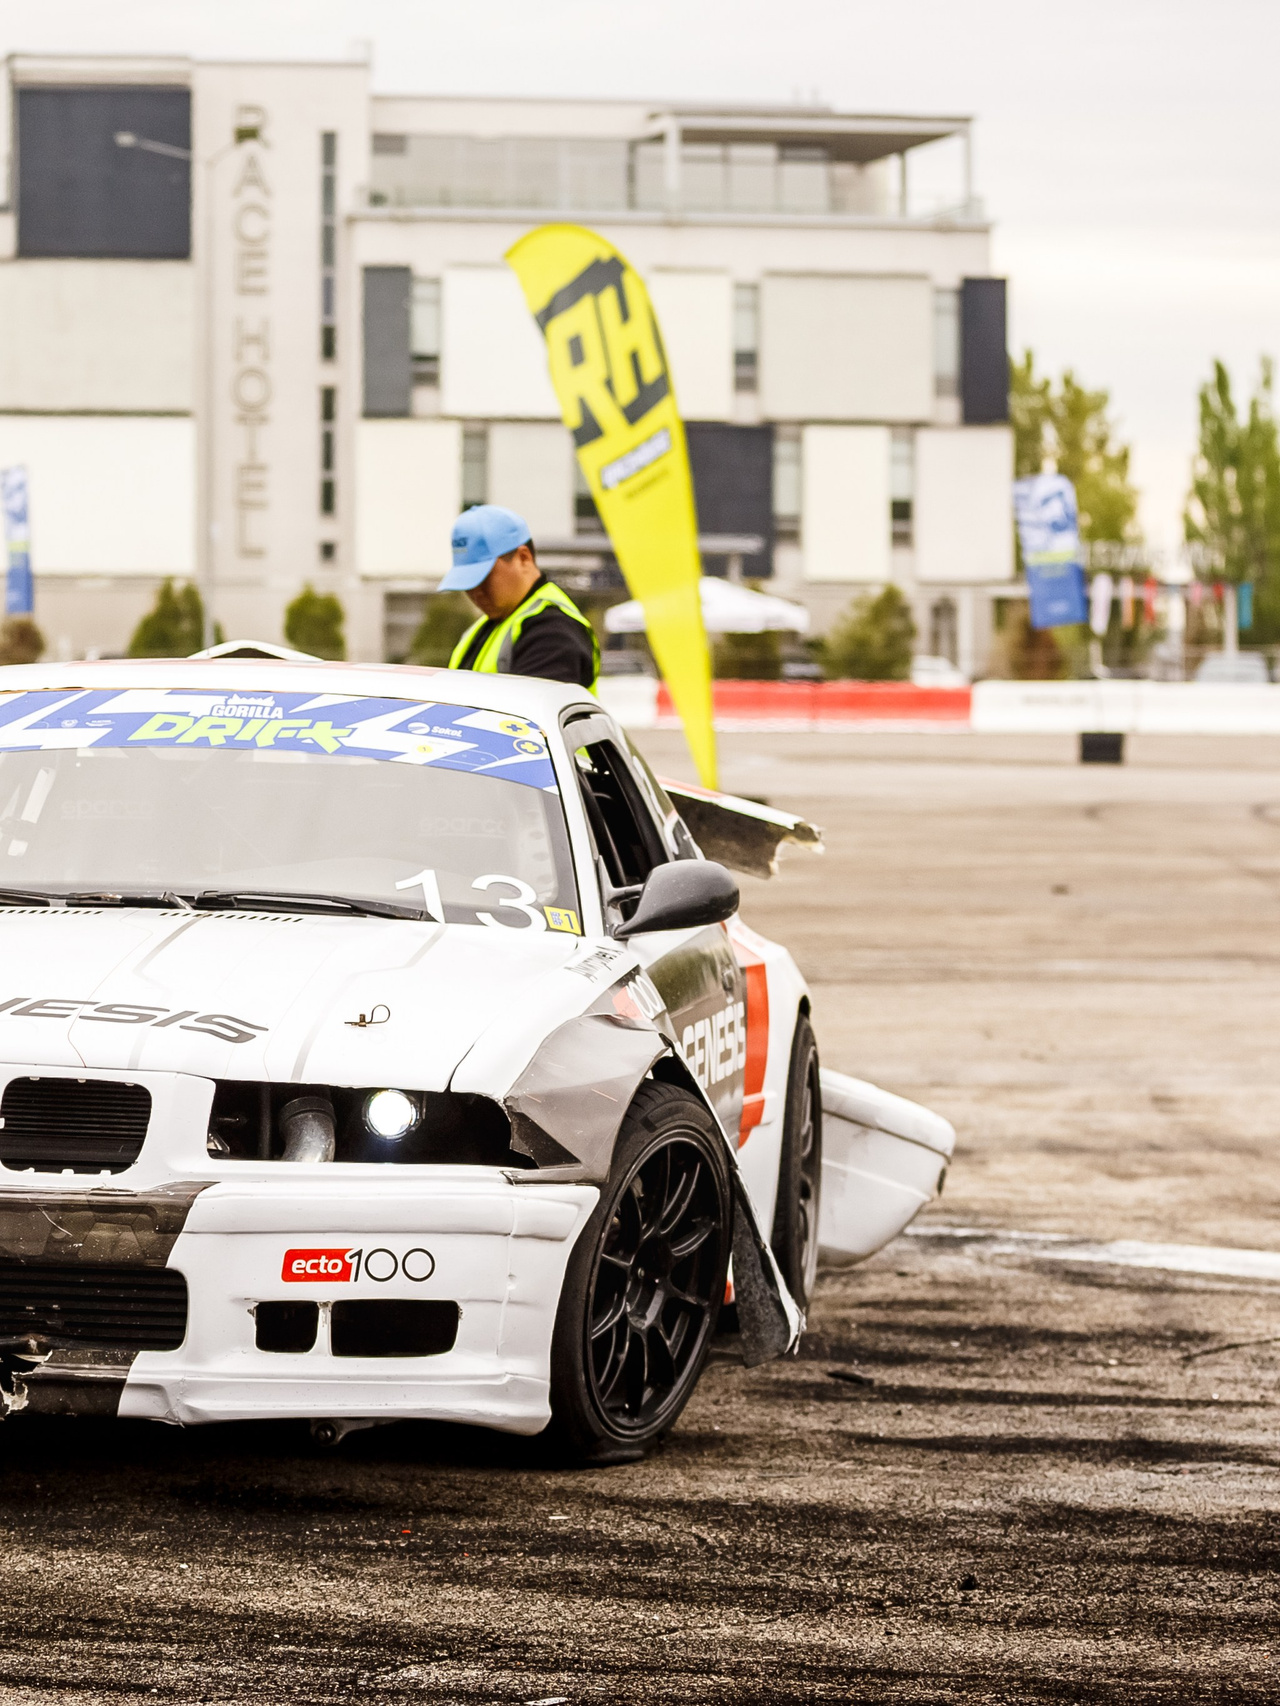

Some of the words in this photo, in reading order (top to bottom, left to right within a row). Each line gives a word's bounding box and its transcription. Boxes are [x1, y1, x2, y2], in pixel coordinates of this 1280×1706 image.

[234, 104, 270, 296] RACE
[233, 318, 271, 559] HOTEL
[127, 713, 353, 754] DRIFT
[211, 704, 283, 719] GORILLA
[395, 869, 547, 931] 13
[683, 1001, 746, 1089] GENESIS
[292, 1248, 435, 1282] ecto100
